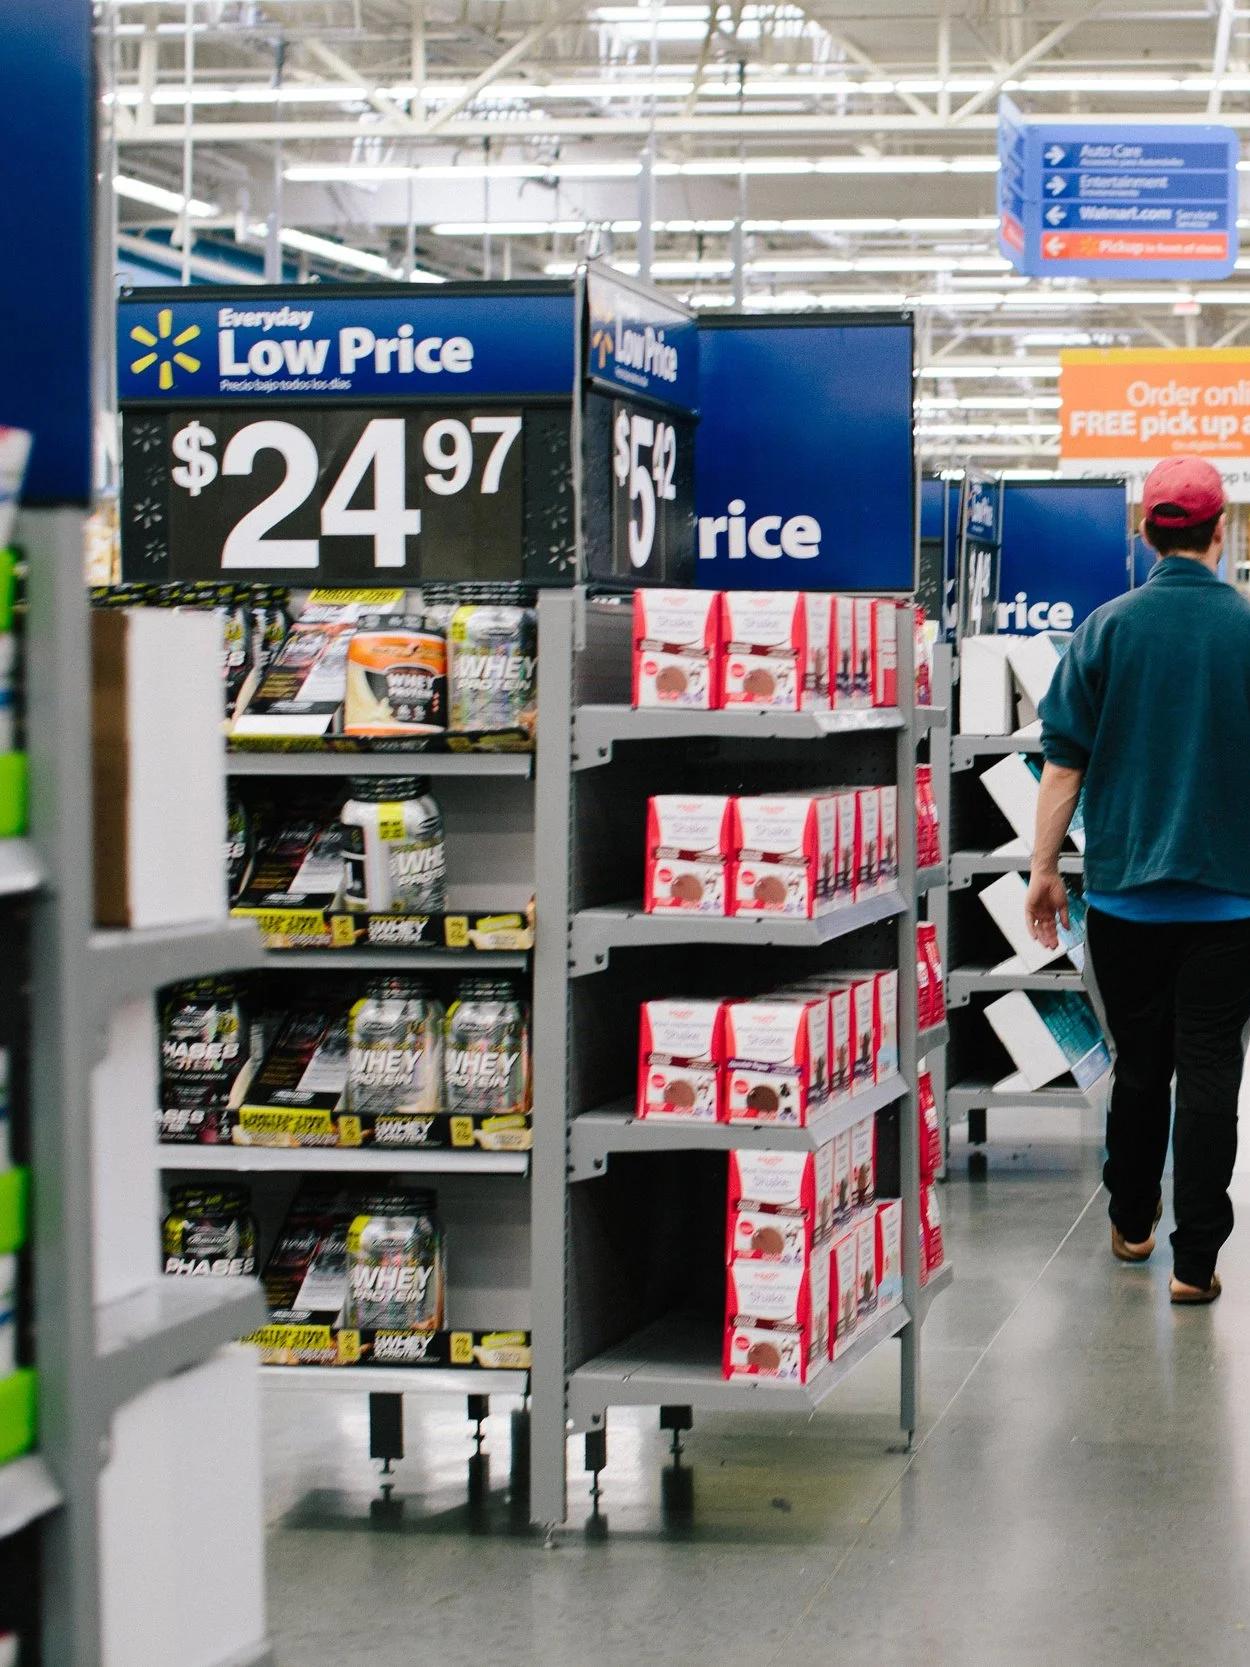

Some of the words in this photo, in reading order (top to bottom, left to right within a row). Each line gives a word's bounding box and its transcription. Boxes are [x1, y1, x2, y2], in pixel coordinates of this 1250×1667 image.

[1079, 206, 1173, 220] Walmart.com
[218, 306, 314, 331] Everyday
[218, 329, 331, 376] Low
[339, 323, 474, 374] Price
[614, 311, 644, 371] Low
[643, 326, 678, 383] Price
[1127, 380, 1201, 407] Order
[1070, 410, 1137, 437] FREE
[1141, 410, 1198, 442] pick
[1201, 414, 1237, 442] up
[699, 499, 822, 560] rice
[997, 591, 1075, 630] rice
[455, 655, 537, 680] WHEY
[350, 1049, 424, 1074] WHEY
[444, 1051, 520, 1076] WHEY
[351, 1265, 434, 1290] WHEY
[353, 1289, 426, 1303] PROTEIN
